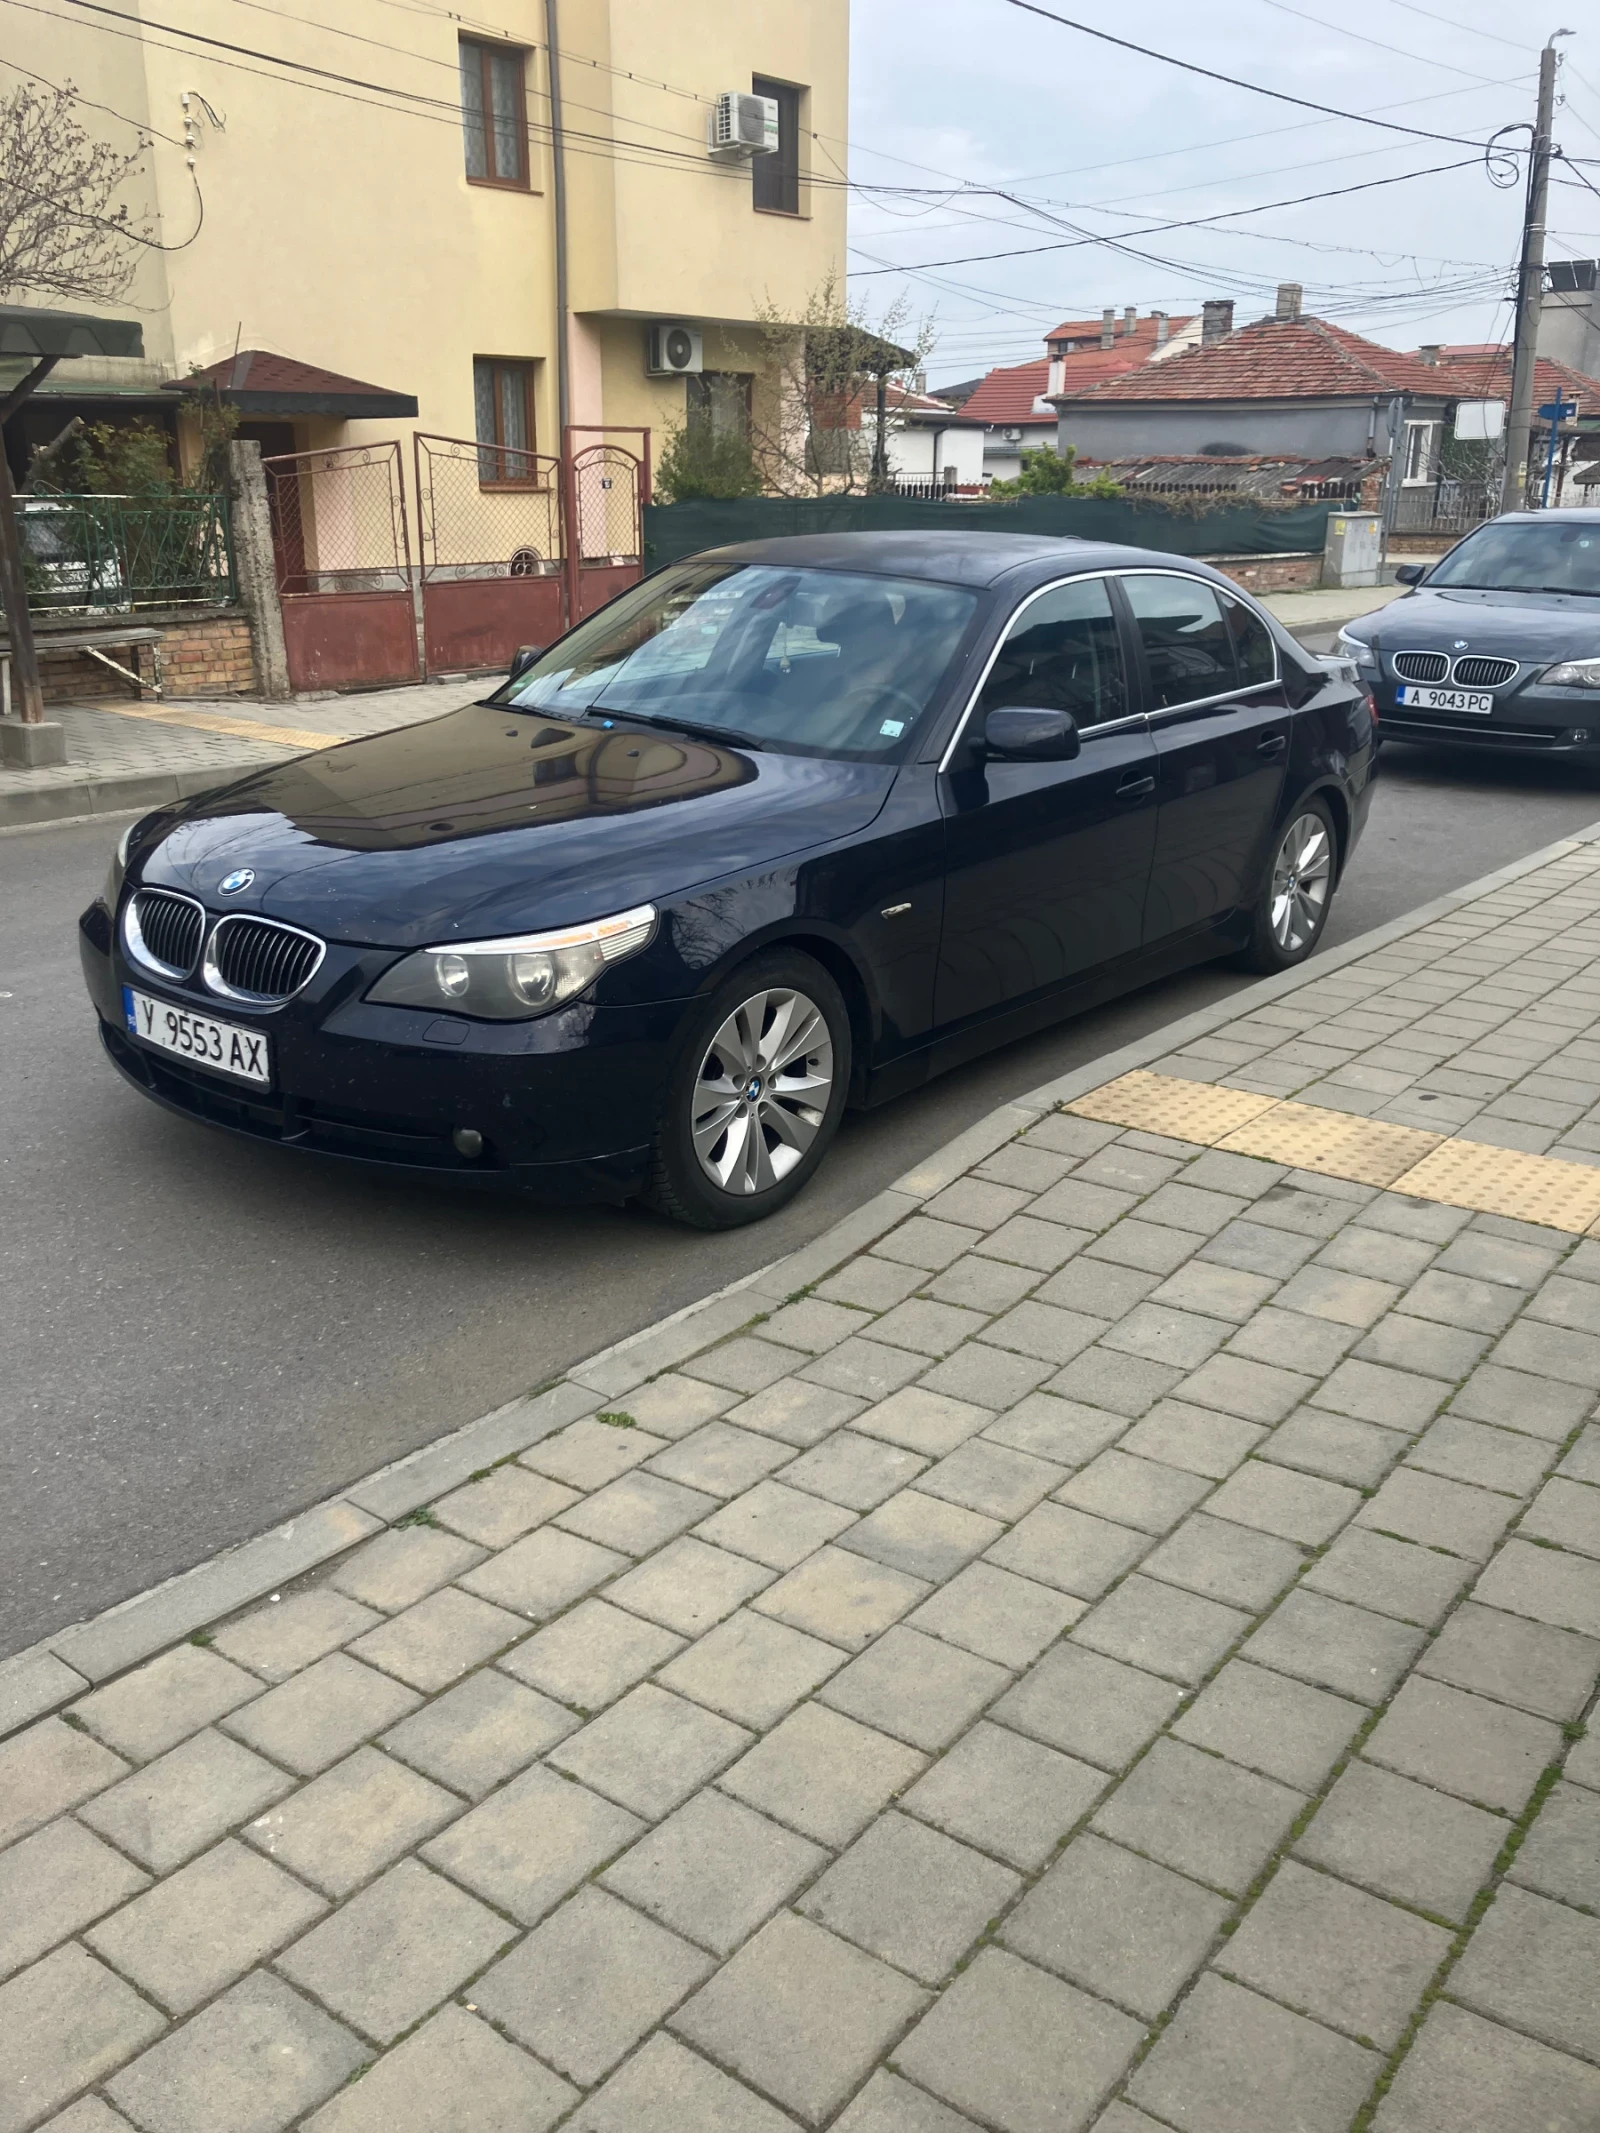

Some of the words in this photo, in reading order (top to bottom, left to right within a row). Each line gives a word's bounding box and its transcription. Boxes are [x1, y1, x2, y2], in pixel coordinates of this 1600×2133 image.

[1411, 689, 1420, 704] A
[1429, 691, 1465, 708] 9043
[1468, 694, 1490, 711] PC
[142, 1000, 154, 1035] Y
[166, 1011, 223, 1061] 9553
[230, 1032, 264, 1075] AX
